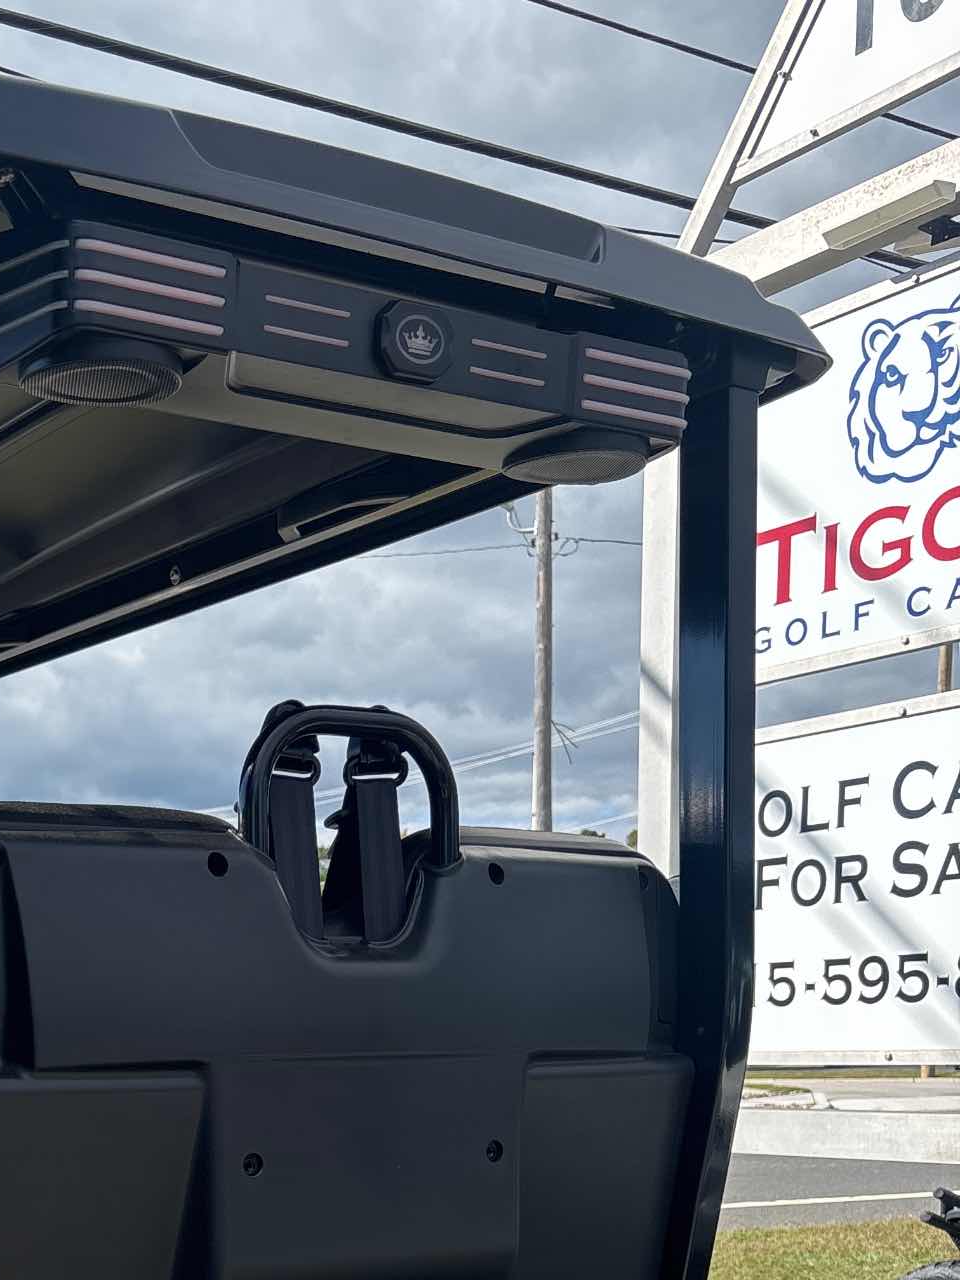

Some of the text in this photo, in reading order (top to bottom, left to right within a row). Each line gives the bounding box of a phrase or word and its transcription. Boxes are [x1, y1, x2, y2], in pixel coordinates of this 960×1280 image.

[755, 599, 874, 654] GOLF
[757, 774, 870, 838] OLF
[754, 854, 868, 910] FOR
[753, 951, 960, 1008] 5-595-
